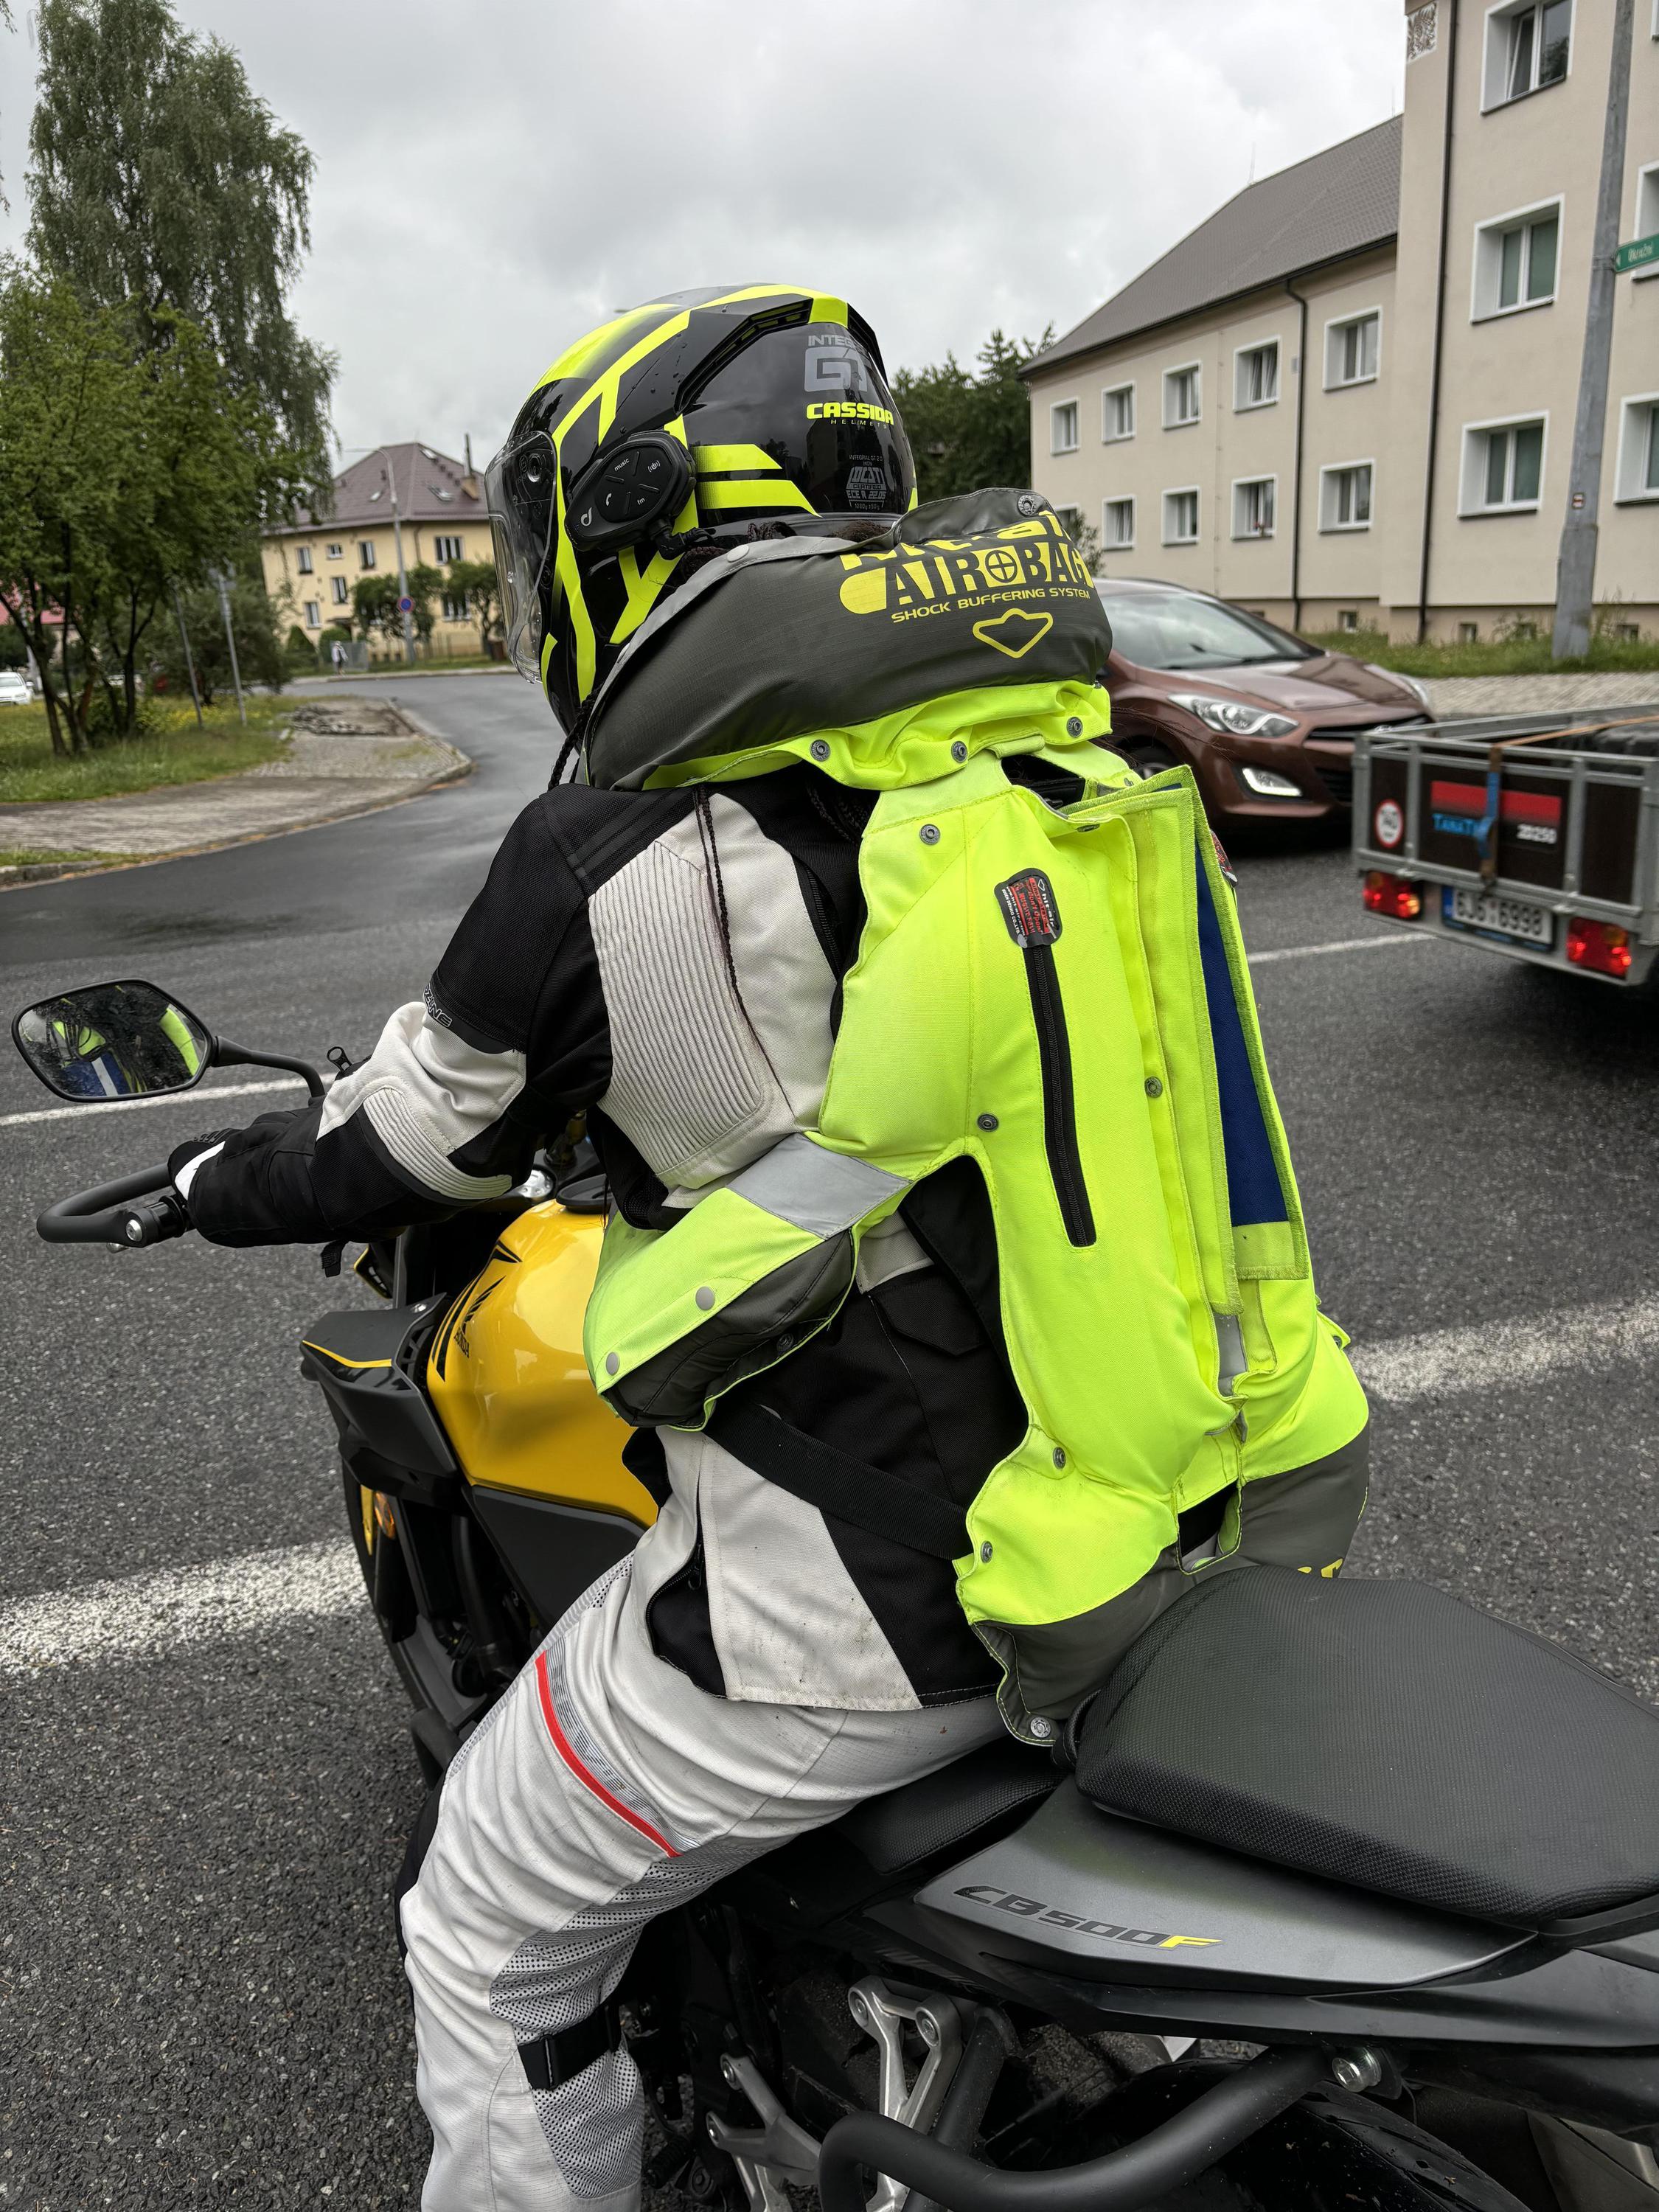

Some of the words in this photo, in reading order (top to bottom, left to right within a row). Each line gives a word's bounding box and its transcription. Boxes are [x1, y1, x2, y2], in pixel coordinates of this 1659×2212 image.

[806, 402, 894, 425] CASSIDA
[614, 458, 630, 472] music
[636, 497, 647, 505] fm
[846, 490, 860, 499] ECE
[891, 602, 951, 624] SHOCK
[958, 588, 1046, 610] BUFFERING
[1049, 587, 1091, 599] SYSTEM
[453, 1326, 470, 1358] HONDA
[953, 1885, 1222, 1950] CB500F
